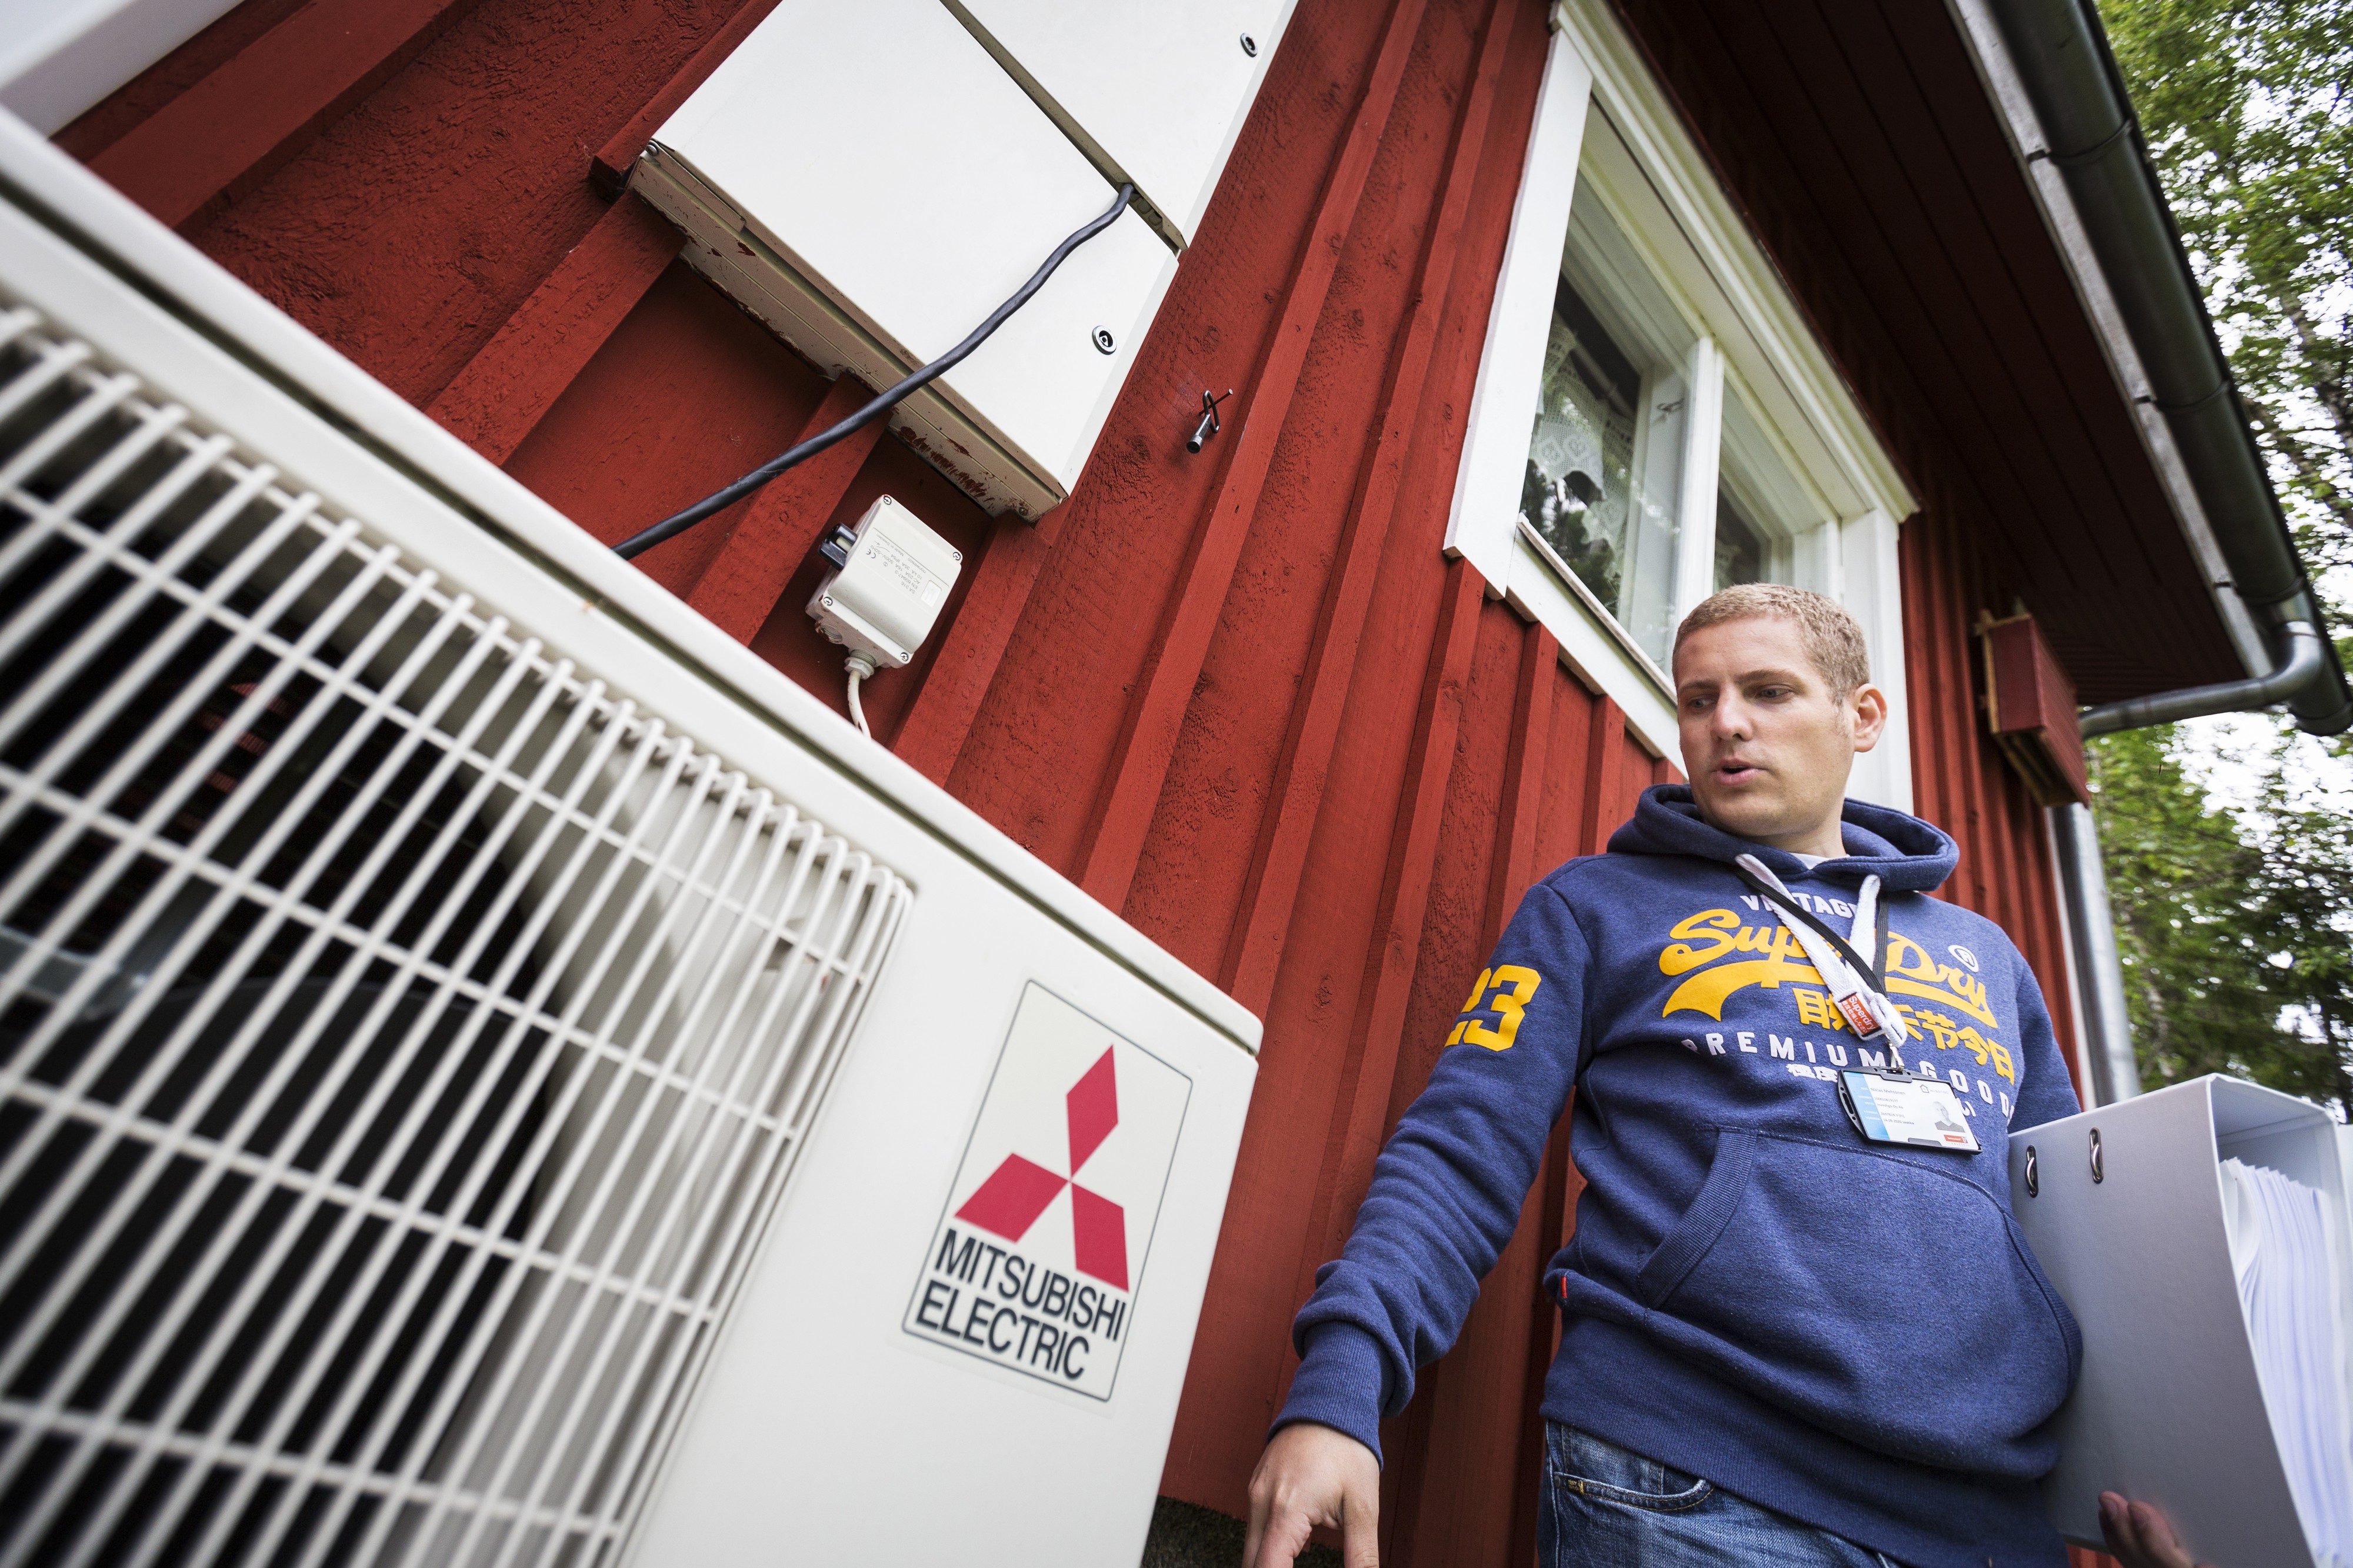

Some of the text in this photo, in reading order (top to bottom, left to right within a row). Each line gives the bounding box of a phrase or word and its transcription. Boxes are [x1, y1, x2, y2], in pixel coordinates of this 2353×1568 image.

[1848, 996, 1876, 1030] Superdry
[915, 1279, 1089, 1380] ELECTRIC
[934, 1228, 1126, 1342] MITSUBISHI
